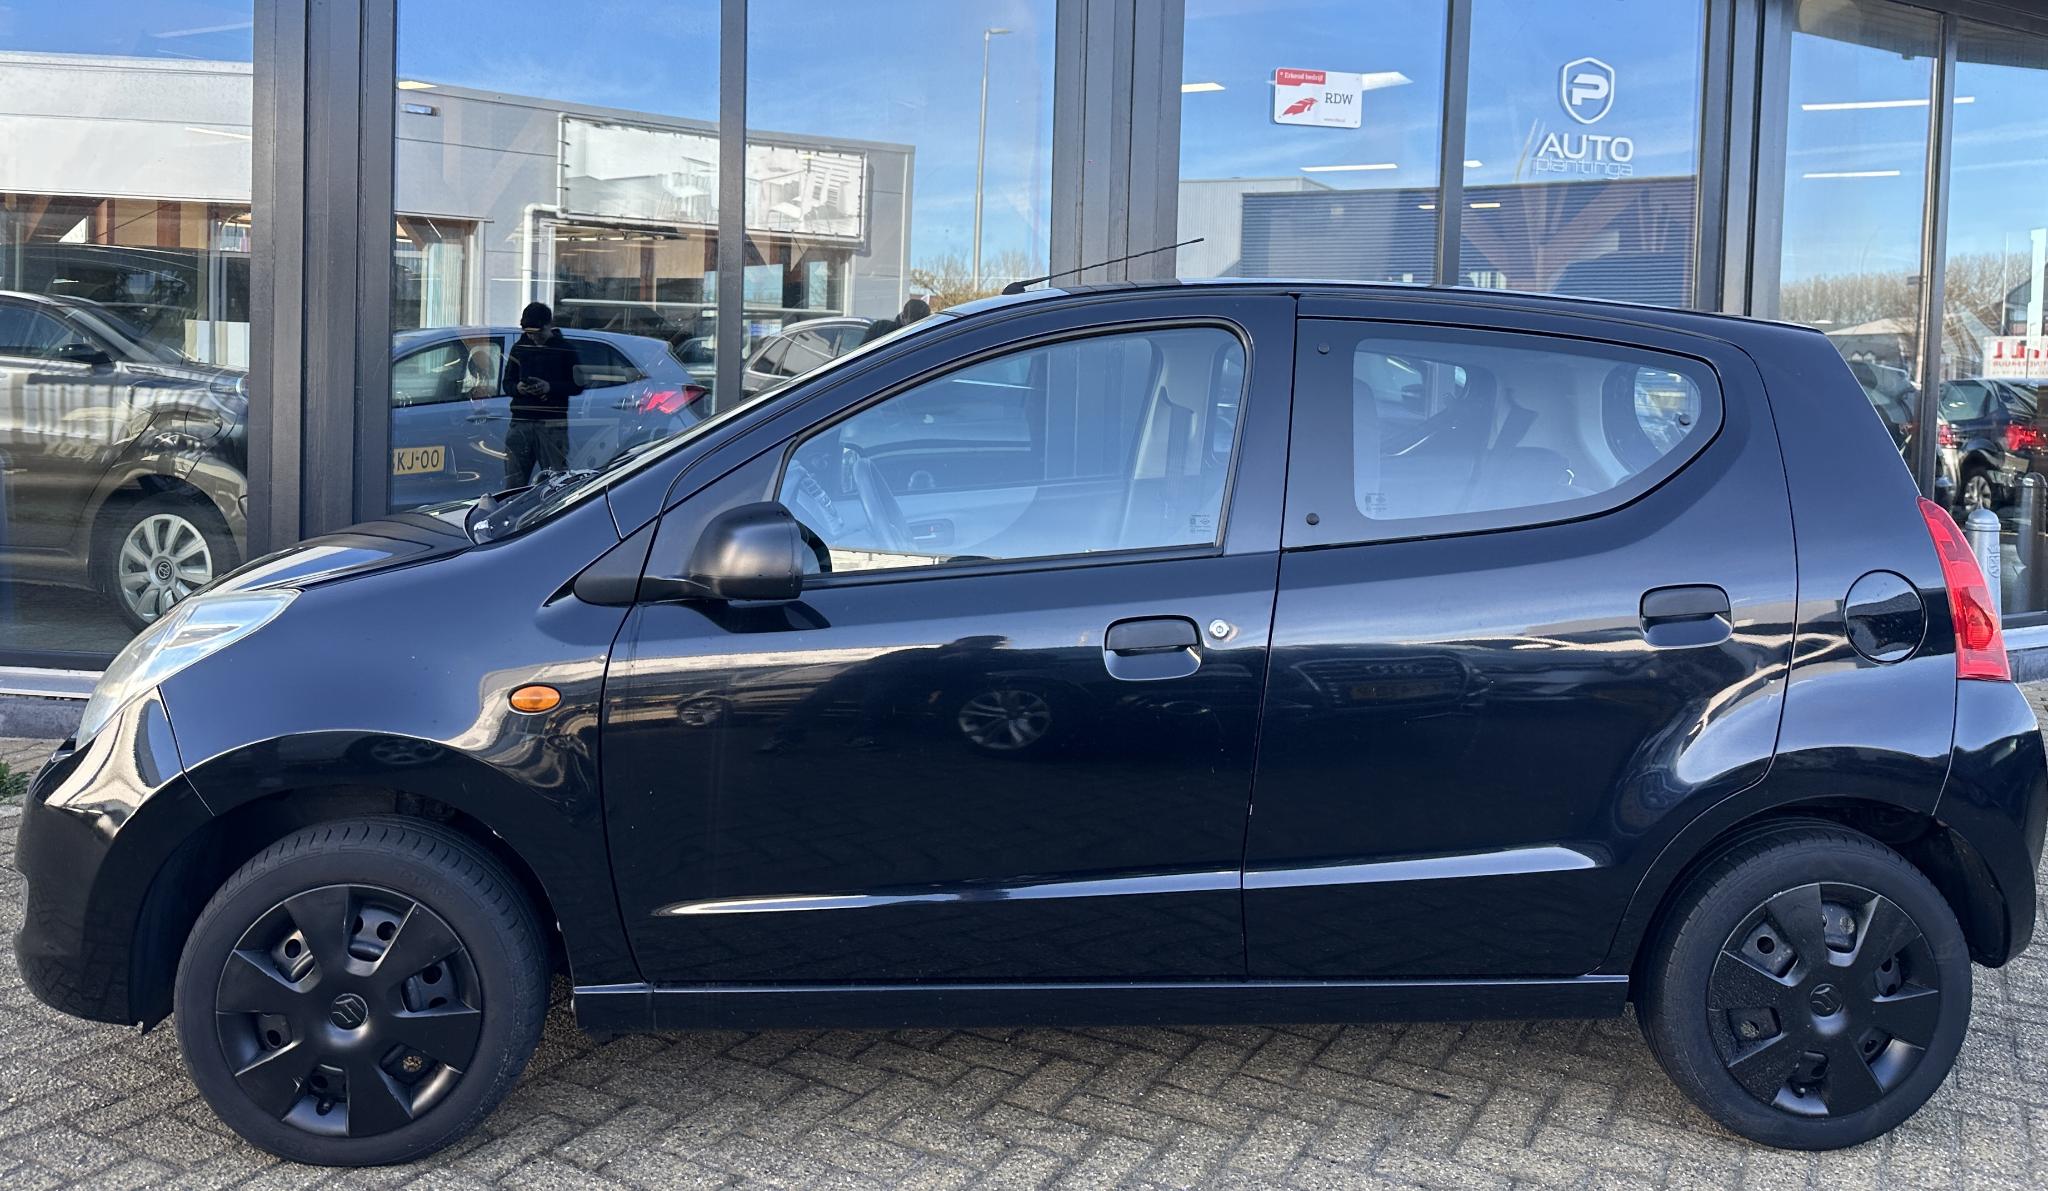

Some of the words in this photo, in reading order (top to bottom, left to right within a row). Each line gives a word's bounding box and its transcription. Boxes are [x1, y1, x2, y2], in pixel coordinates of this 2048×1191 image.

[1325, 92, 1354, 105] RDW
[1537, 132, 1634, 162] AUTO
[1535, 157, 1633, 180] plantinga
